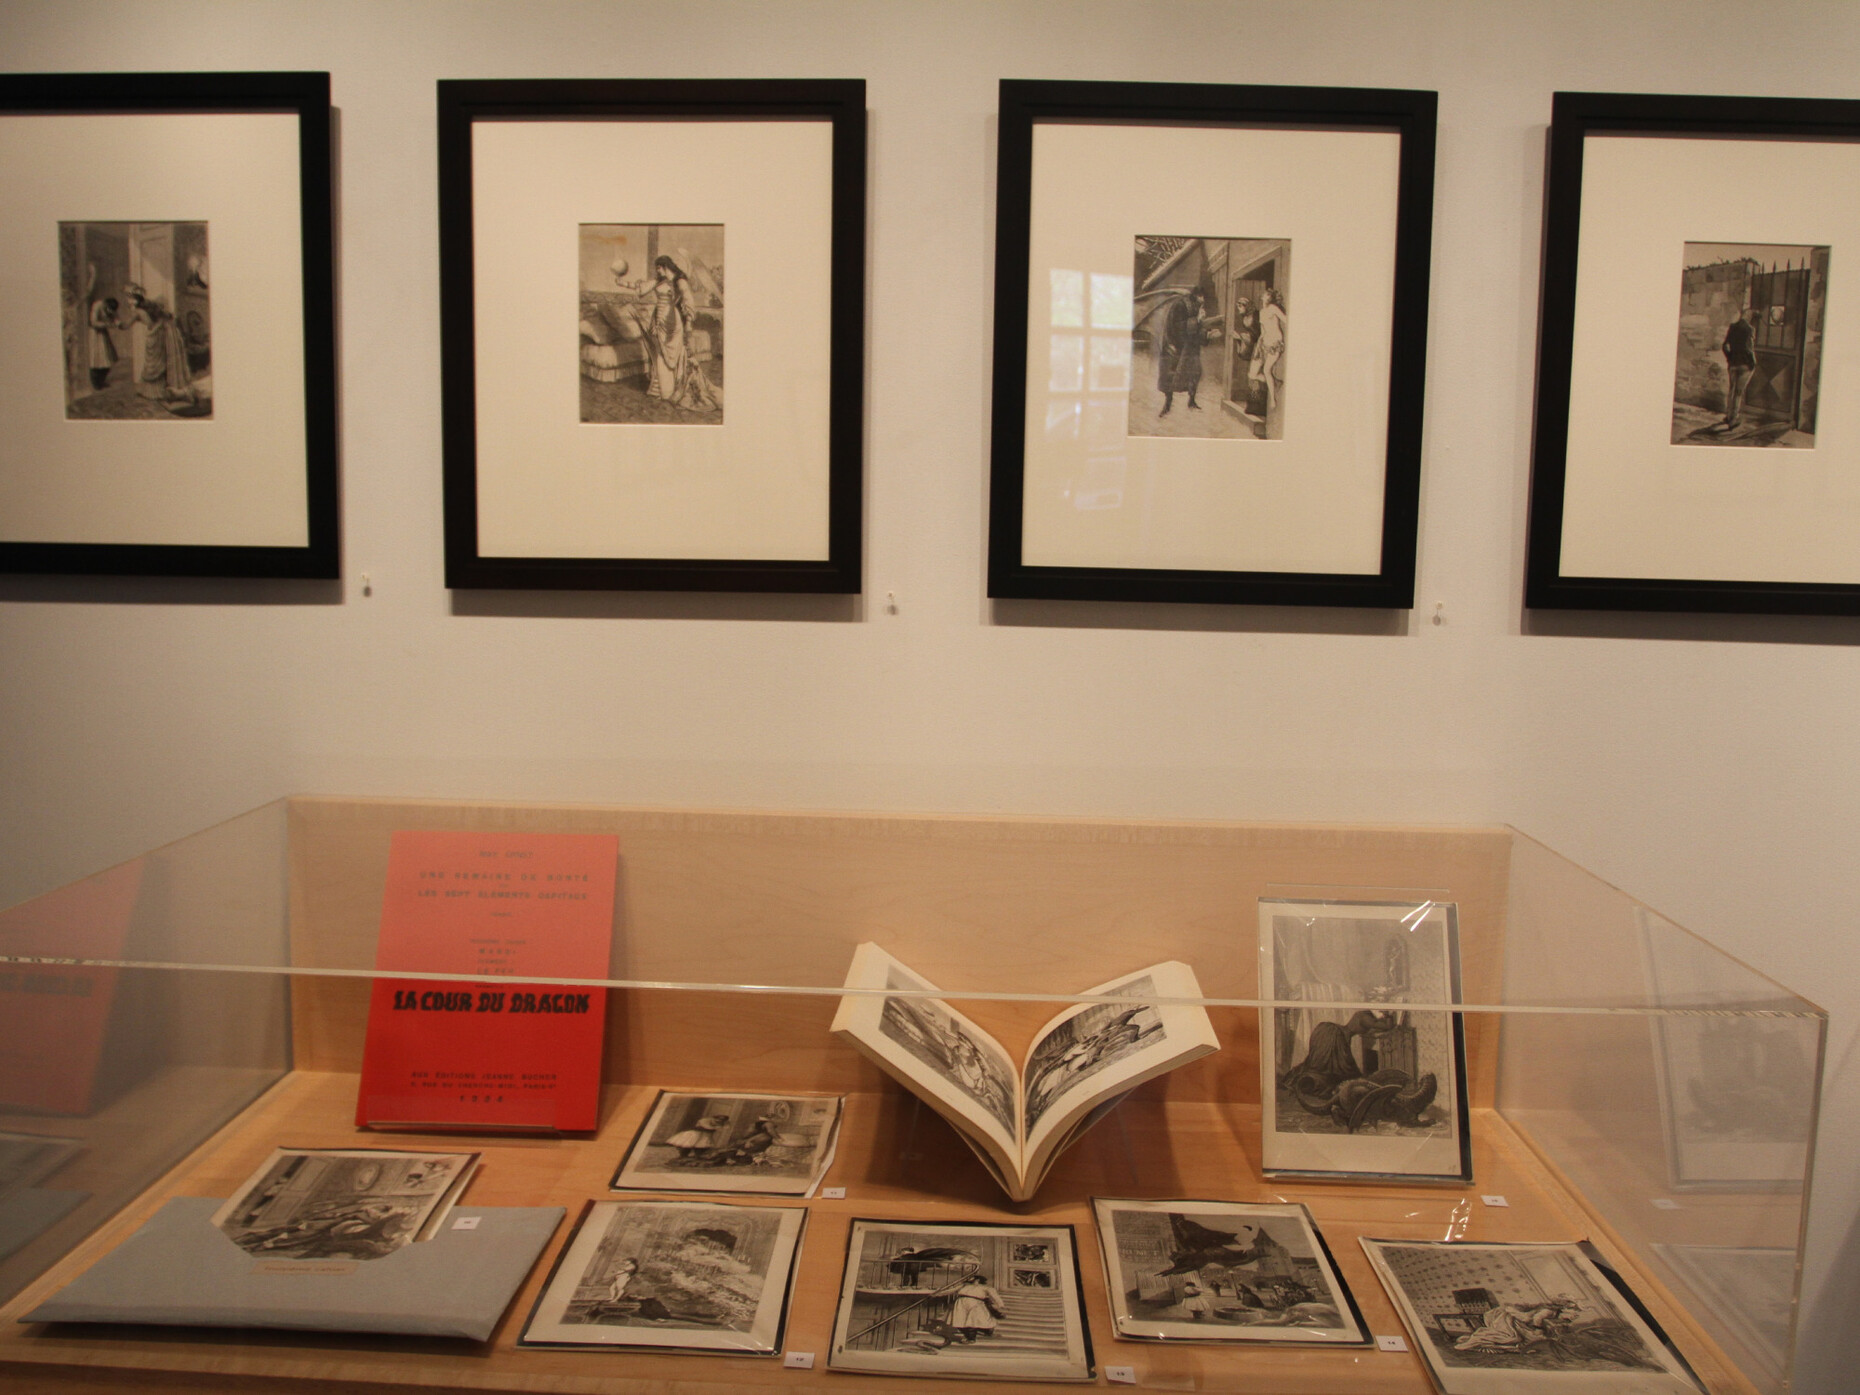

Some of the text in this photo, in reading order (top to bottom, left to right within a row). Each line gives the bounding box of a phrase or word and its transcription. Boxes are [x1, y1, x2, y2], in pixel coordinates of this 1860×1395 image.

[419, 871, 445, 880] UNE
[454, 872, 512, 881] SEMAINE
[521, 873, 537, 881] DE
[418, 889, 438, 897] LES
[445, 890, 471, 899] SEPT
[393, 990, 591, 1014] LA COUR DU DRAGON
[522, 1073, 558, 1081] BUCHER
